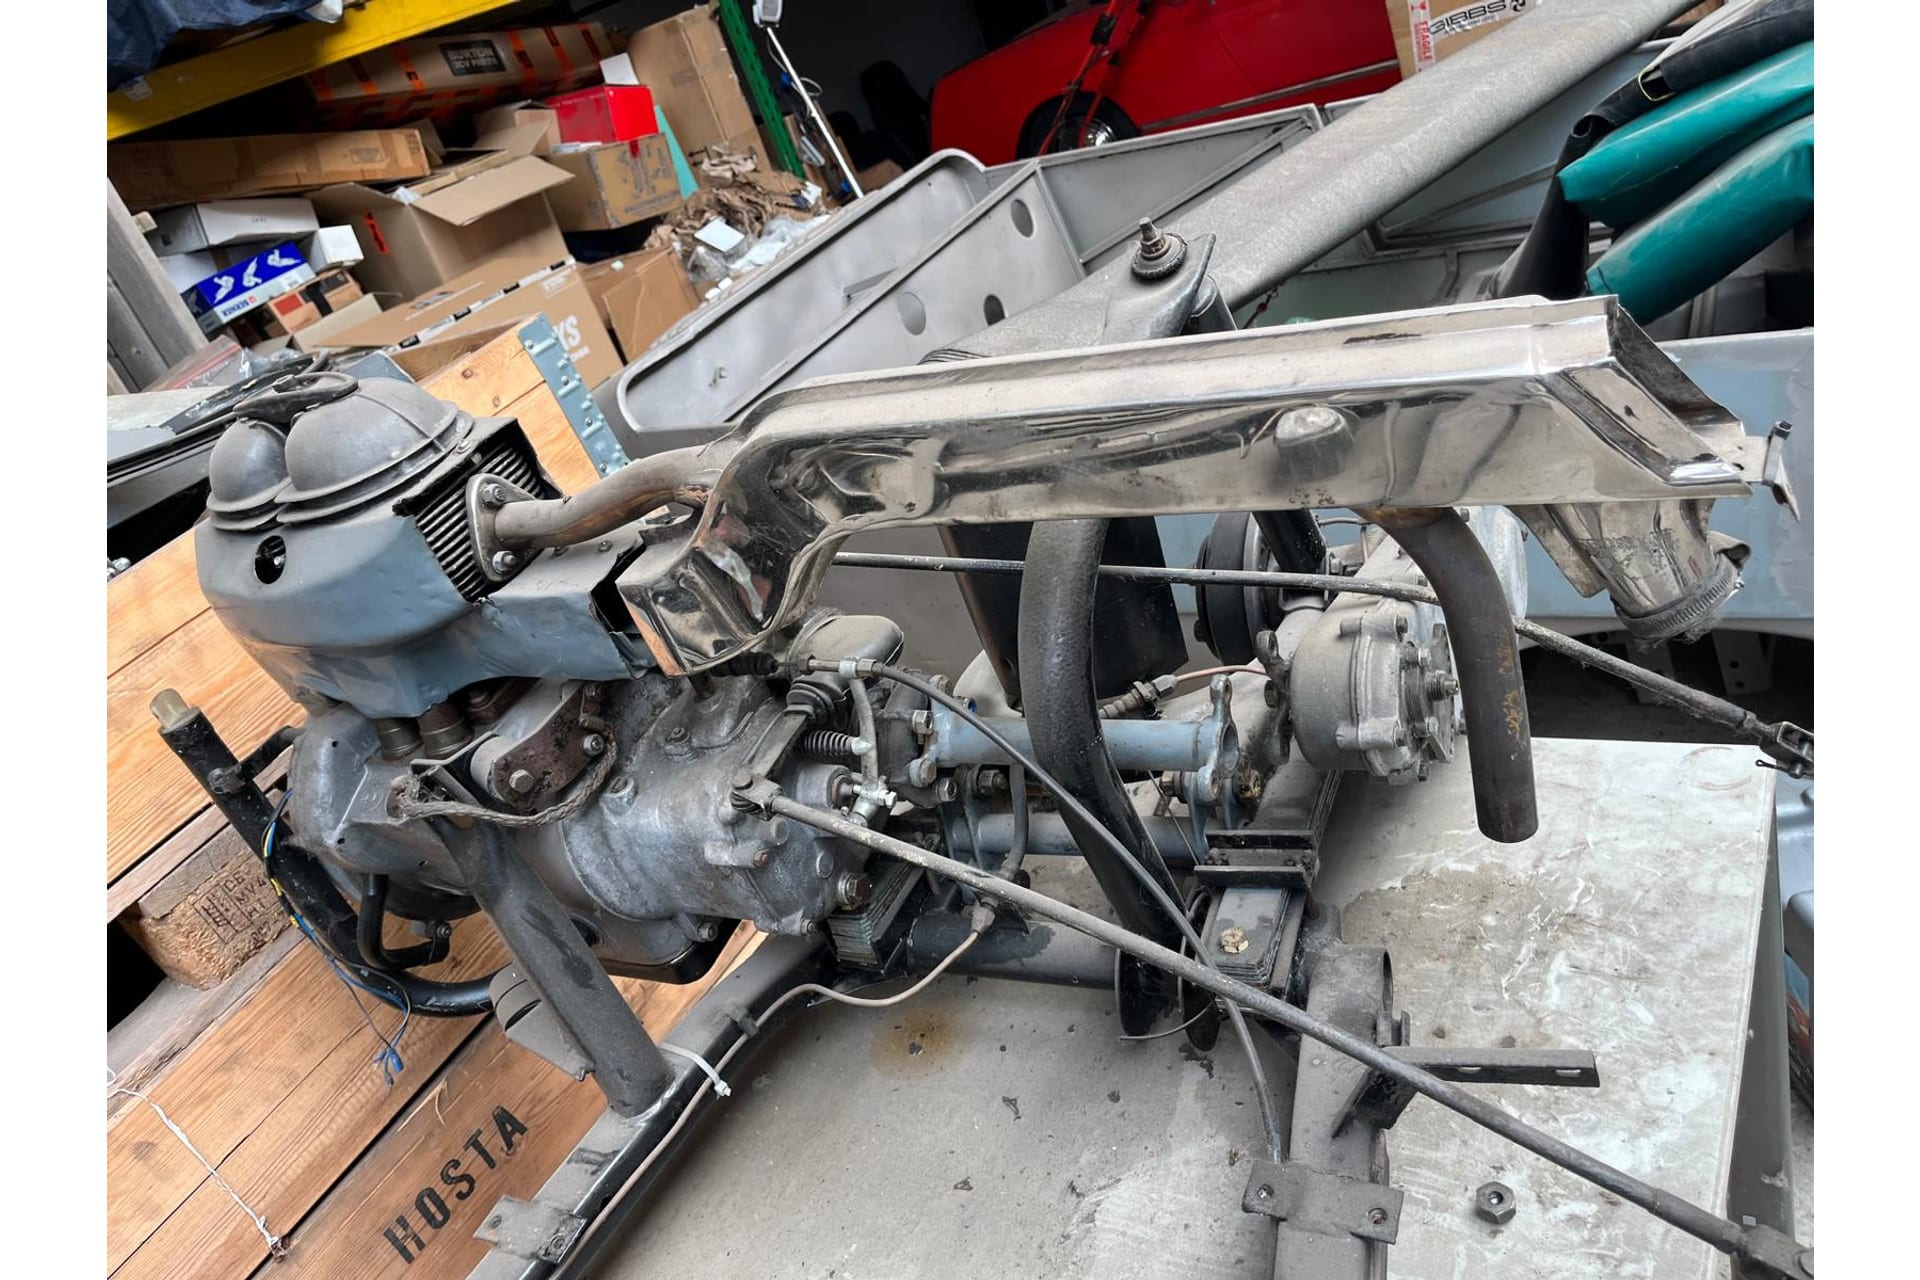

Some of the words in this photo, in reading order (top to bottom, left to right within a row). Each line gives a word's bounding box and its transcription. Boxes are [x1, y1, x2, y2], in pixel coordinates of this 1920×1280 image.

[1428, 1, 1507, 35] GIBBS
[1420, 21, 1433, 60] FRAGILE
[383, 1104, 528, 1265] HOSTA
